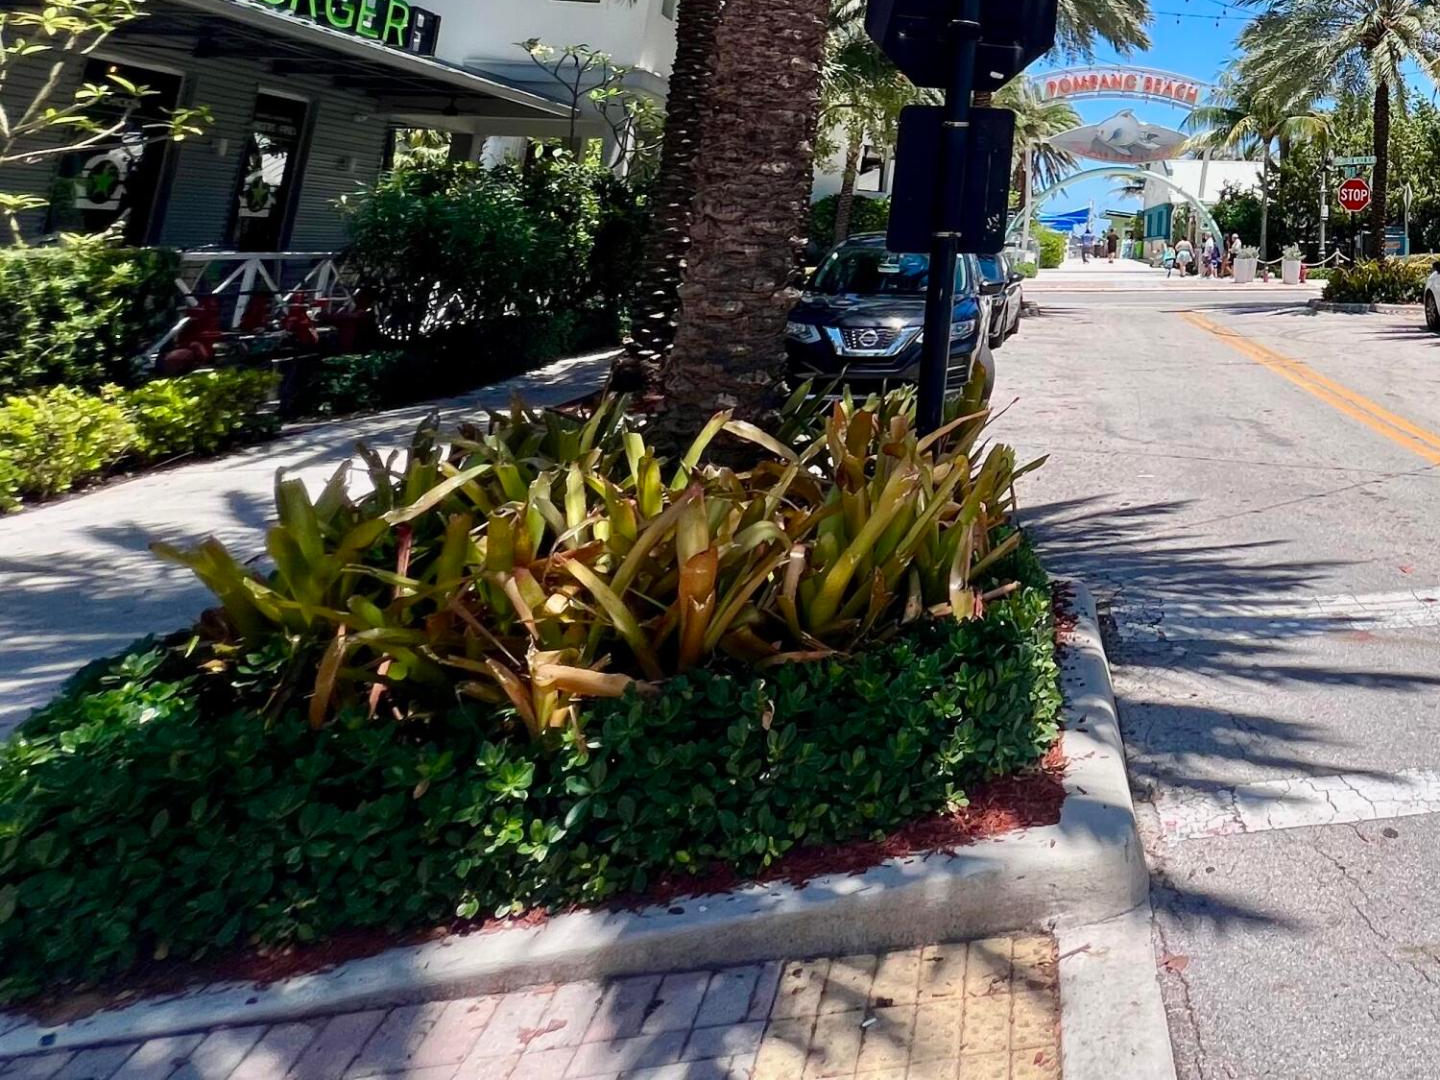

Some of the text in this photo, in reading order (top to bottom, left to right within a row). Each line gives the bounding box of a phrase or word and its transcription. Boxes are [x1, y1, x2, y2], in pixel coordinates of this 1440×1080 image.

[1046, 74, 1199, 105] POMPANO BEACH
[1340, 188, 1368, 201] STOP
